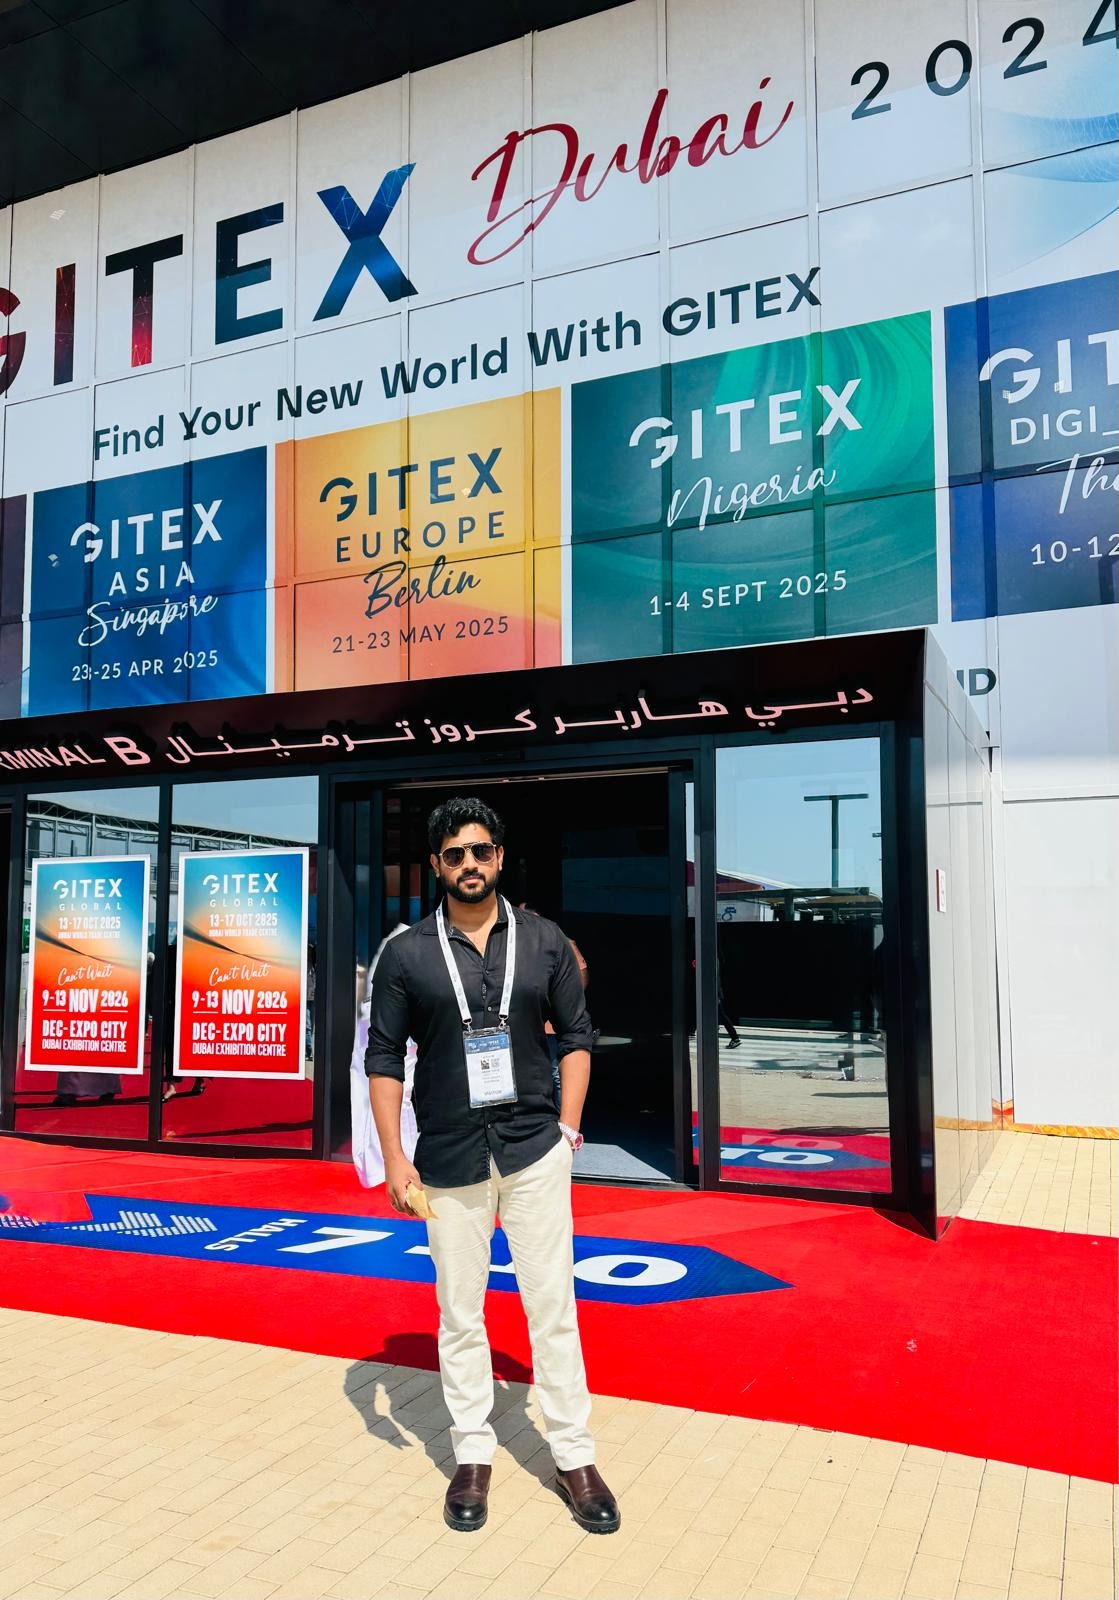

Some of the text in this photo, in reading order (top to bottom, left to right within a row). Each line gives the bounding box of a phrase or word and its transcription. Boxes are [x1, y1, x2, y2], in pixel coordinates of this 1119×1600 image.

[468, 76, 794, 266] Dubai
[850, 0, 1119, 121] 2024
[93, 266, 822, 461] Find Your New World With GITEX
[629, 378, 863, 469] GITEX
[318, 446, 503, 523] GITEX
[665, 462, 837, 531] Nigeria
[70, 499, 223, 564] GITEX
[336, 510, 505, 563] EUROPE
[108, 560, 195, 597] ASIA
[364, 554, 481, 619] Berlin
[649, 569, 848, 615] 1-4 SEPT 2025
[78, 591, 219, 647] Singapore
[332, 615, 509, 654] 21-23 MAY 2025
[71, 649, 219, 682] 23-25 APR 2025
[165, 687, 874, 764] دبي هاربر كروز ترمينال
[103, 736, 151, 766] B
[53, 878, 123, 899] GITEX
[203, 872, 279, 895] GITEX
[59, 902, 122, 911] GLOBAL
[209, 897, 279, 908] GLOBAL
[58, 916, 121, 930] 13-17 OCT 2025
[209, 912, 278, 927] 13-17 OCT 2025
[57, 963, 114, 986] Can't Wait
[209, 961, 272, 987] Can't Wait
[42, 988, 129, 1014] 9-13 NOV 2026
[191, 989, 288, 1015] 9-13 NOV 2026
[69, 1020, 98, 1039] EXPO
[100, 1020, 127, 1039] CITY
[222, 1022, 254, 1042] EXPO
[257, 1023, 287, 1042] CITY
[42, 1038, 127, 1053] DUBAI EXHIBITION CENTRE
[192, 1042, 287, 1057] DUBAI EXHIBITION CENTRE
[204, 1218, 308, 1252] HALLS
